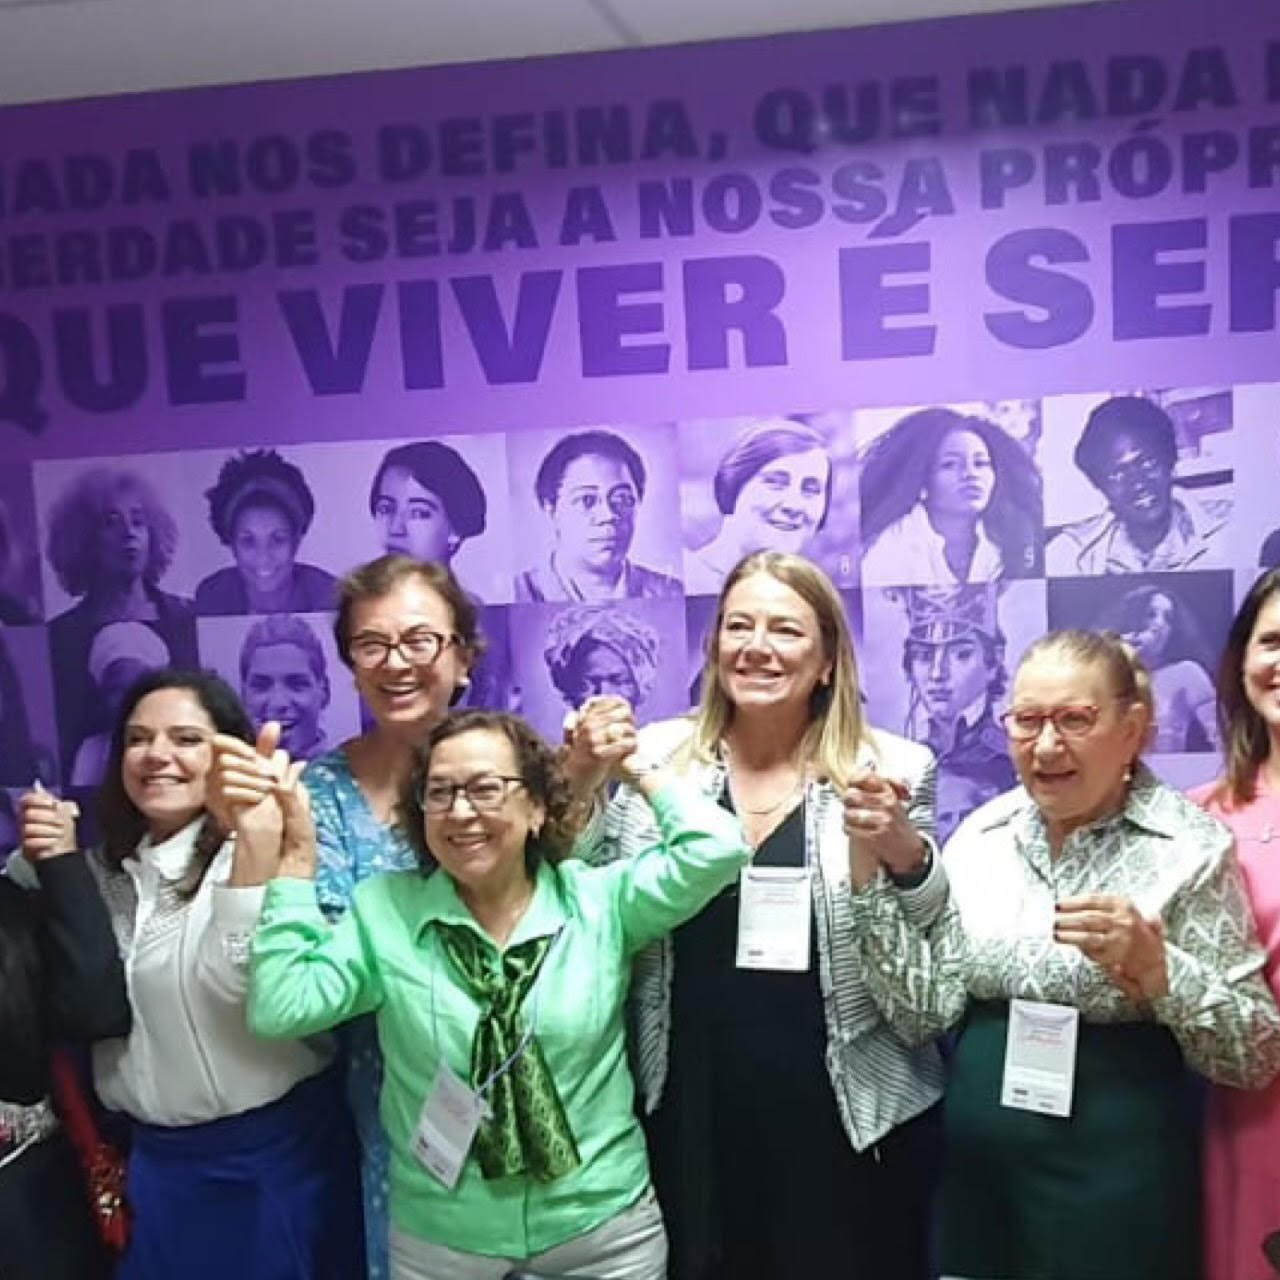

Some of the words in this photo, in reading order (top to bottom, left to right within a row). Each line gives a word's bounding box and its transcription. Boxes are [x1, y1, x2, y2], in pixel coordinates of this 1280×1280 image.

[187, 127, 357, 199] NOS
[378, 97, 730, 183] DEFINA,
[753, 75, 944, 155] QUE
[966, 46, 1239, 130] NADA
[339, 192, 539, 264] SEJA
[559, 186, 617, 246] A
[638, 157, 955, 237] NOSSA
[276, 254, 789, 397] VIVER
[838, 213, 938, 362] É
